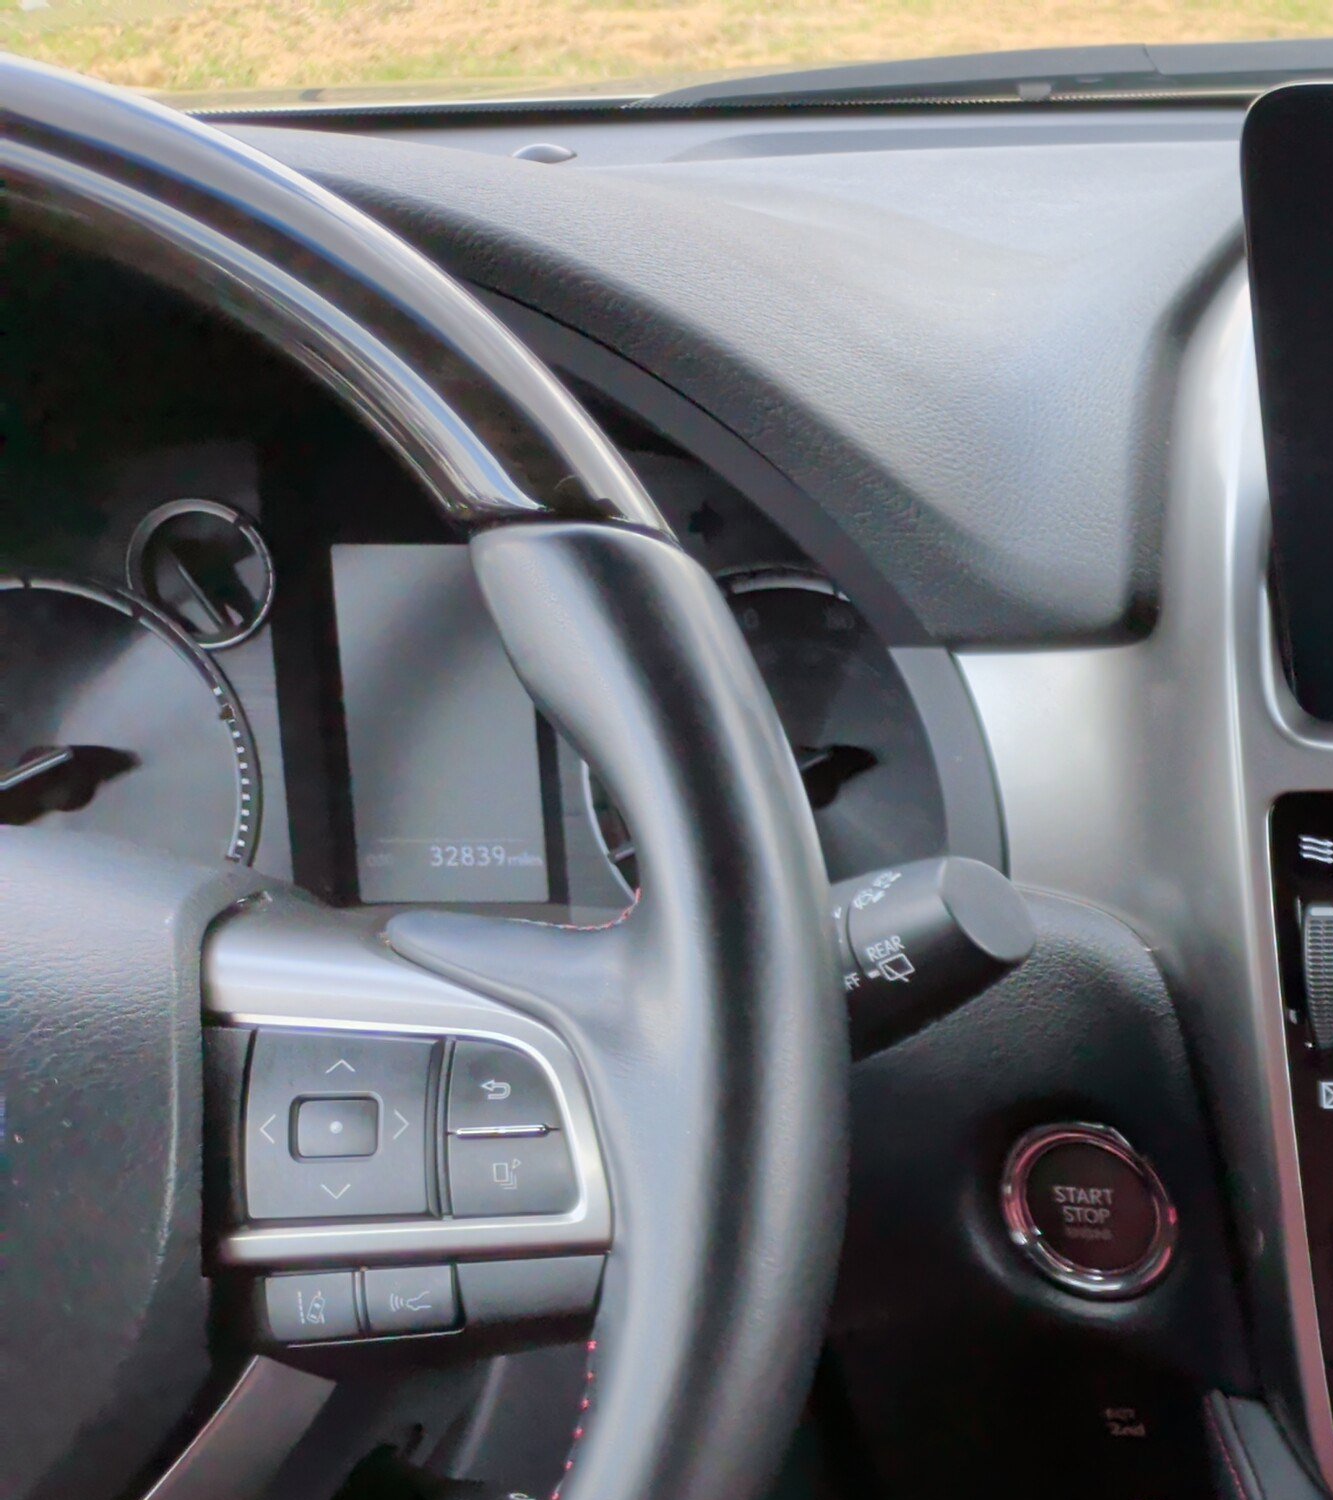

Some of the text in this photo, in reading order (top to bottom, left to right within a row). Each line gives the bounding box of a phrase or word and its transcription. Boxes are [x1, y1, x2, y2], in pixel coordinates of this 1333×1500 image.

[430, 845, 506, 867] 32839
[866, 935, 905, 962] REAR
[843, 973, 861, 991] FF
[1053, 1185, 1114, 1206] START
[1062, 1206, 1111, 1224] STOP
